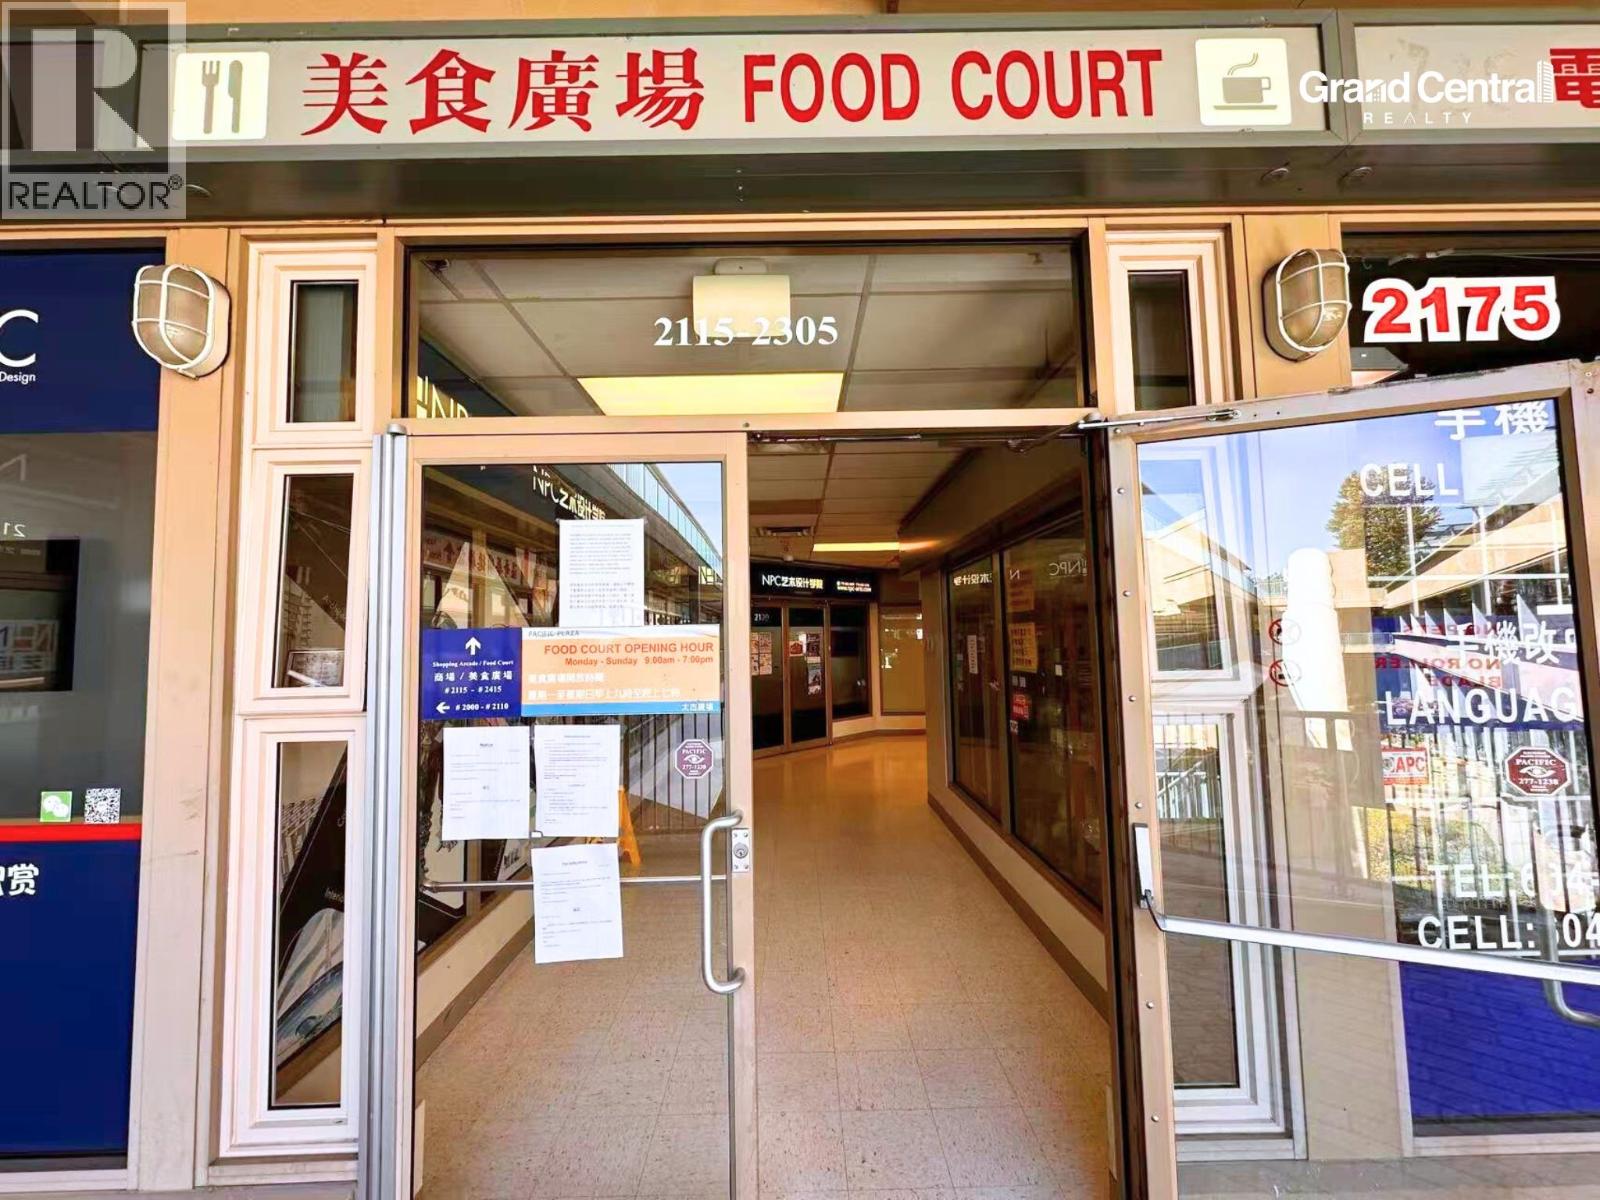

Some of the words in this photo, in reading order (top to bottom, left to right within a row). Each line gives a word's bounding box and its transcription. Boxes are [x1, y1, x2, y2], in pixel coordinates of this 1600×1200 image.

[301, 48, 705, 136] 美食廣場
[744, 52, 921, 124] FOOD
[951, 48, 1163, 121] COURT
[1366, 279, 1557, 340] 2175
[653, 315, 838, 348] 2115-2305
[1434, 400, 1550, 441] 手機
[1360, 462, 1459, 498] CELL
[544, 644, 577, 655] FOOD
[580, 643, 621, 655] COURT
[624, 642, 678, 654] OPENING
[680, 641, 714, 653] HOUR
[565, 657, 598, 667] Monday
[606, 656, 637, 667] Sunday
[1385, 686, 1578, 726] LANGUAG
[1515, 758, 1557, 767] PACIFIC
[0, 863, 40, 897] 赏
[1418, 914, 1535, 950] CELL:
